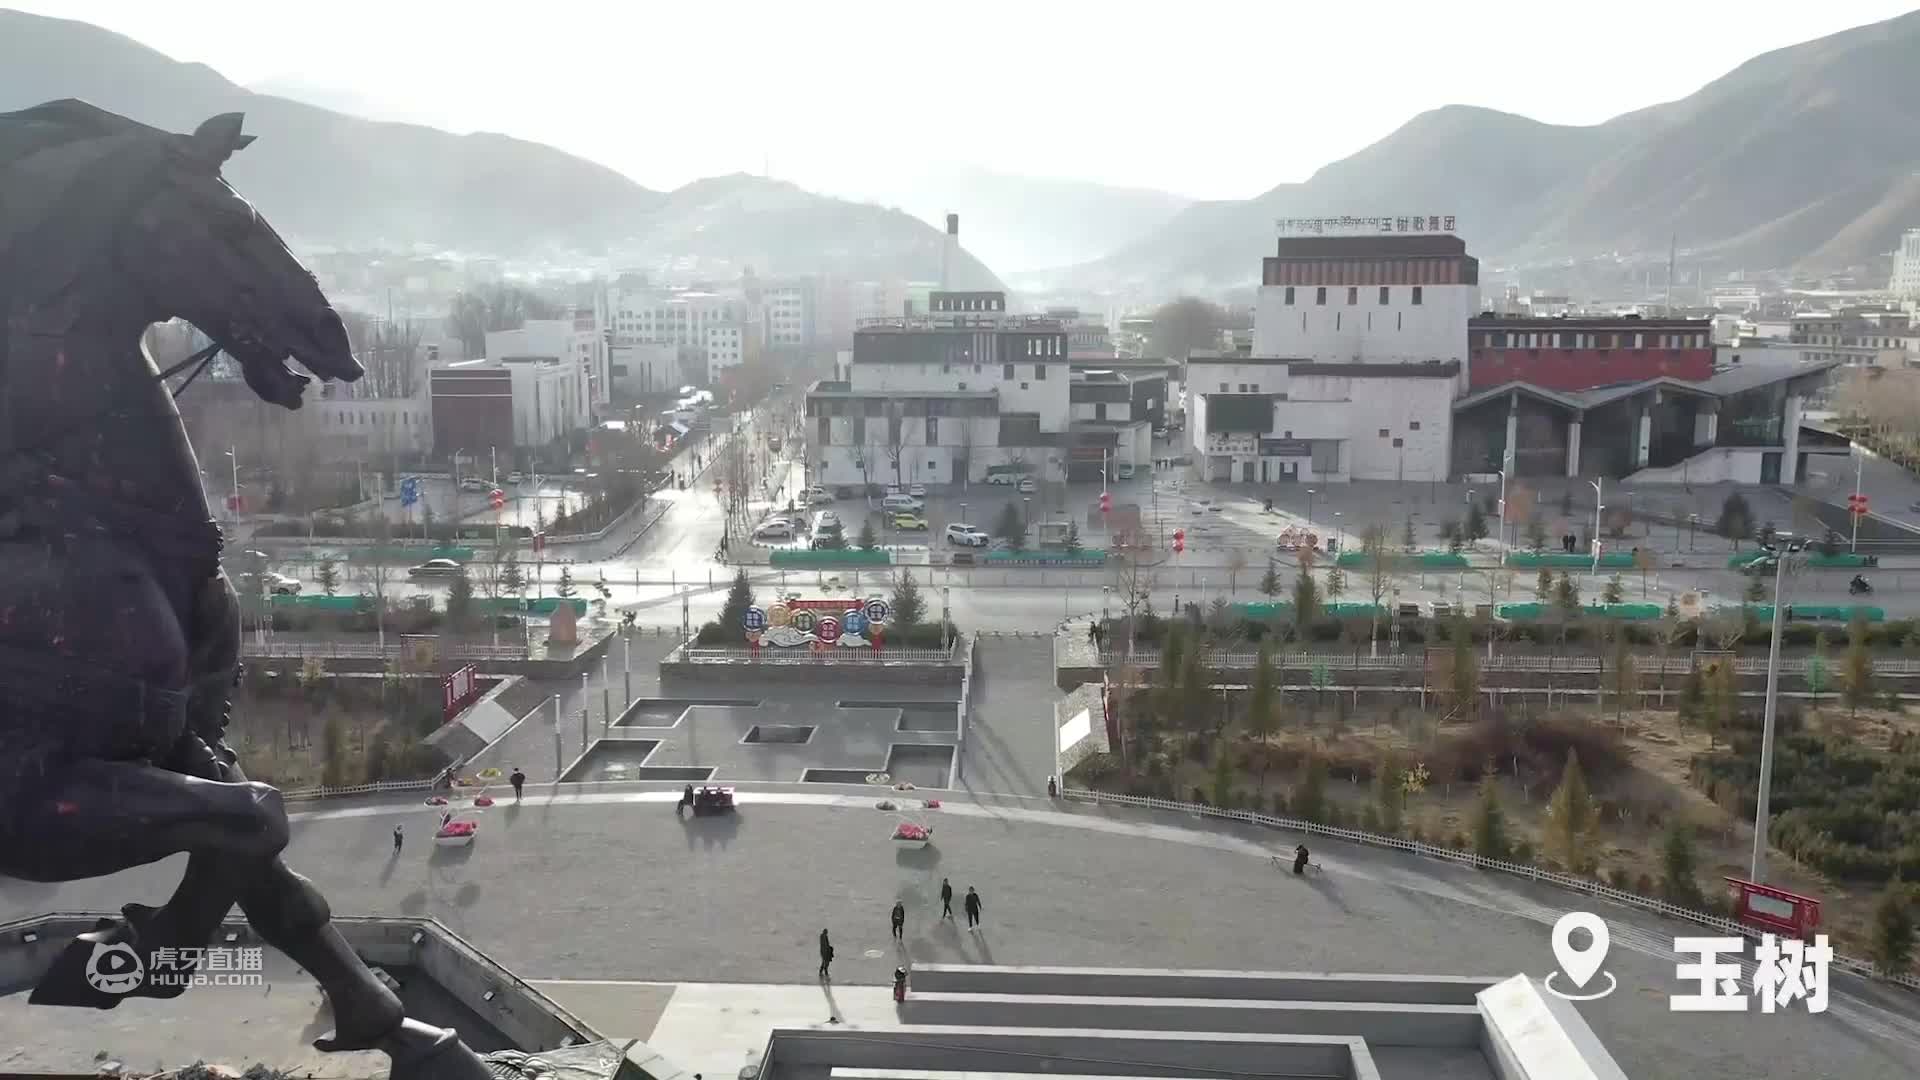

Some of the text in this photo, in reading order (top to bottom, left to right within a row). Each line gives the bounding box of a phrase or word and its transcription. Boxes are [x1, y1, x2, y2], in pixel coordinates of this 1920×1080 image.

[1381, 216, 1455, 232] 玉树歌舞团
